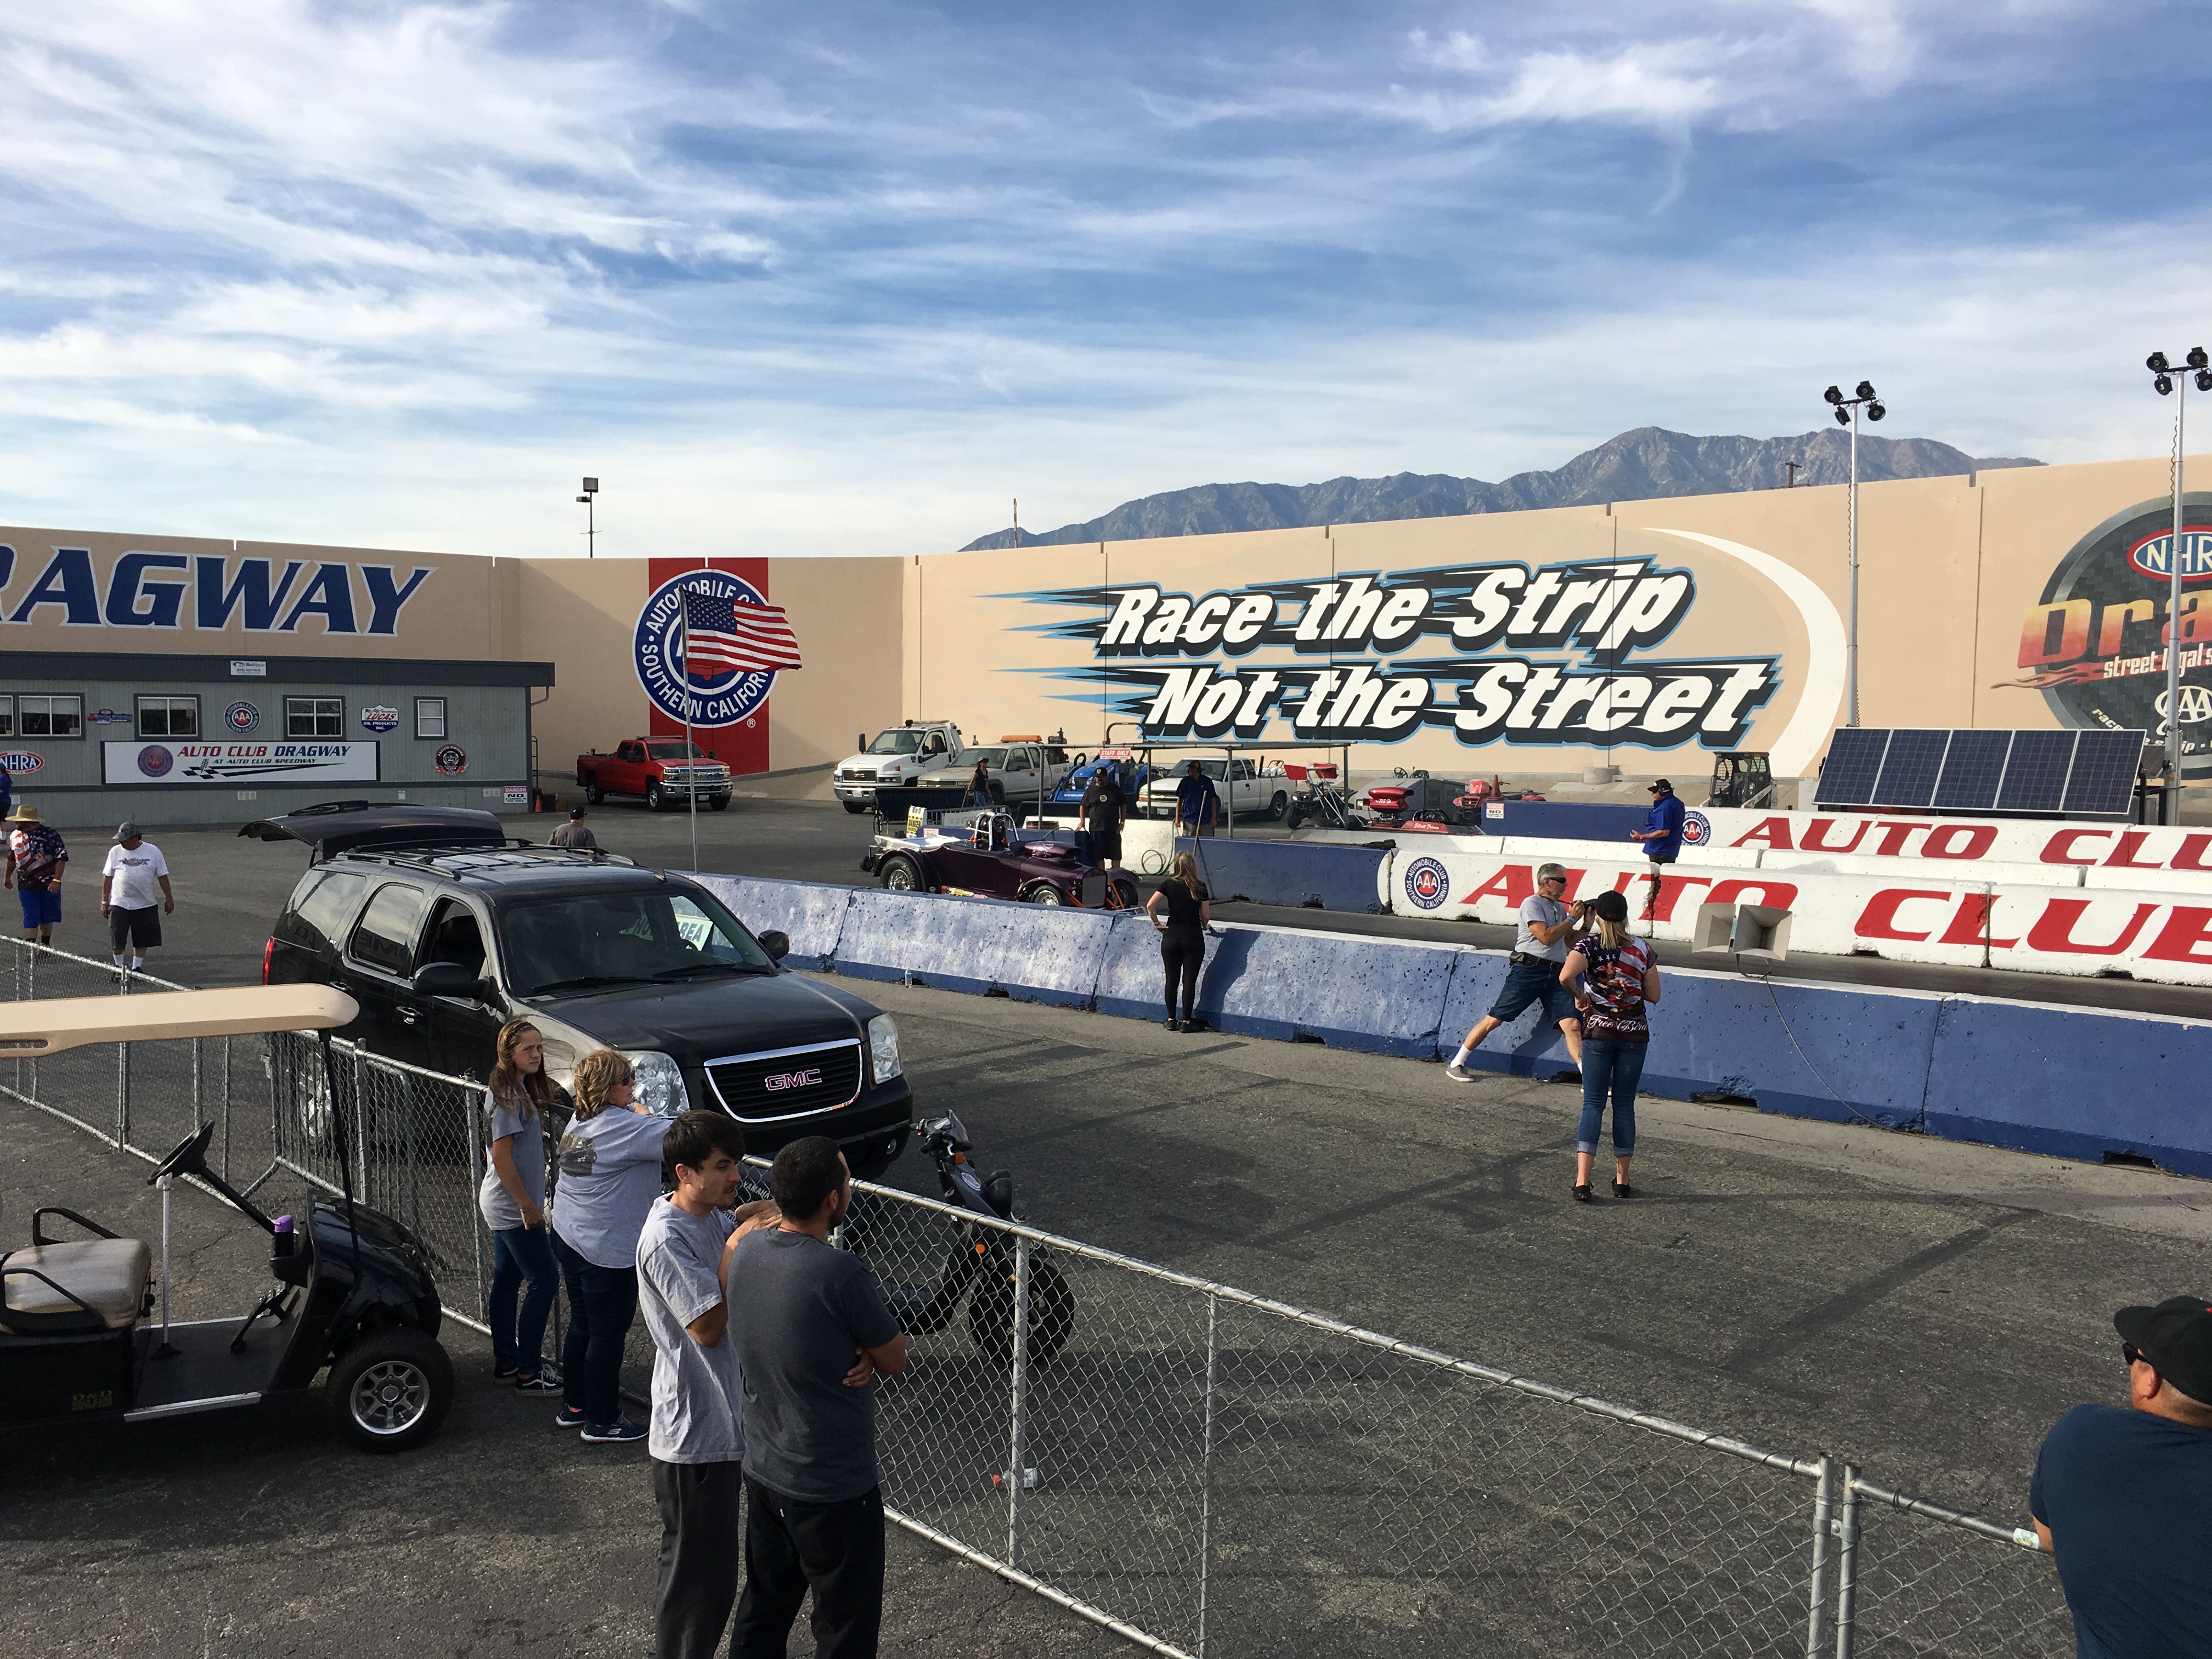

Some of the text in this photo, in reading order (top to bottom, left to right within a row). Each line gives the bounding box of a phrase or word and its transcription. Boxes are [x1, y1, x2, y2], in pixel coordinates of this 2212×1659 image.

[2147, 536, 2212, 572] NHR
[0, 543, 437, 636] AGWAY
[1099, 563, 1688, 649] Race the Strip
[2017, 589, 2212, 668] Dra
[2103, 651, 2158, 679] street
[2162, 642, 2204, 678] lgal
[641, 644, 769, 719] SOUTHERN CALIFOR
[1143, 662, 1768, 733] Not the Street
[234, 712, 250, 721] AAA
[2092, 708, 2124, 730] race
[177, 746, 351, 757] AUTO CLUB DRAGWAY
[2154, 740, 2195, 754] sip
[0, 755, 37, 770] NHRA
[1683, 823, 1701, 835] AAA
[1699, 816, 1709, 827] CLUB
[1729, 817, 2212, 870] AUTO CLU
[1408, 859, 1447, 879] AUTOMOBILE CLUB
[1417, 874, 1437, 889] AAA
[1406, 880, 1448, 908] SOUTHERN CALIFORNIA
[1587, 1014, 1613, 1029] Free
[765, 1069, 822, 1091] GMC
[743, 1181, 770, 1199] YAMAHA
